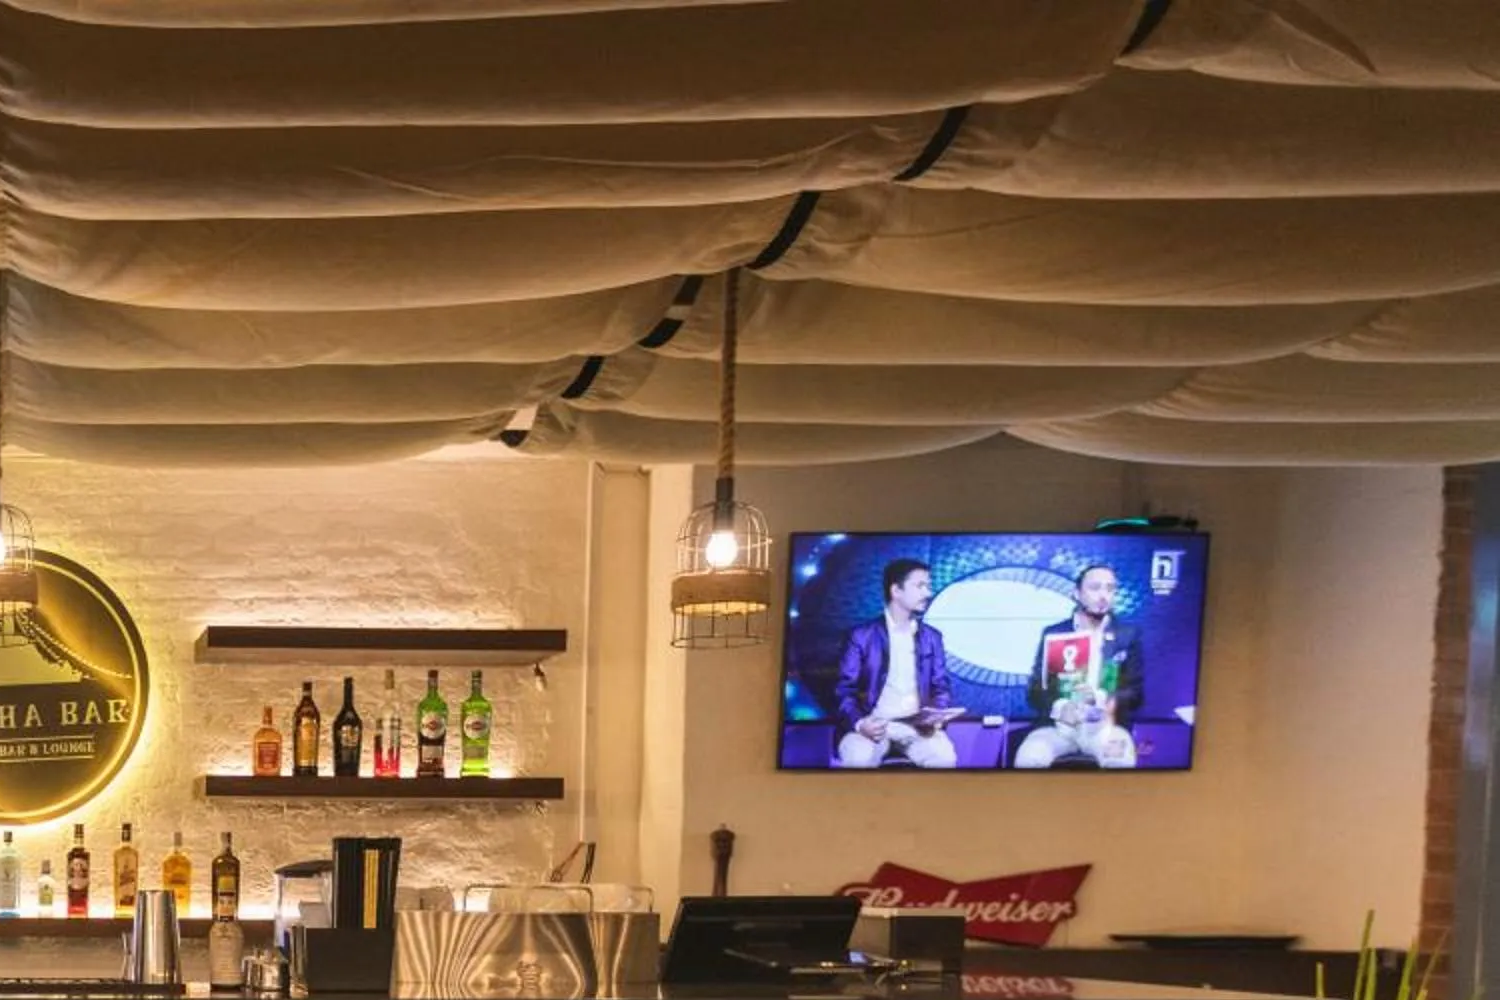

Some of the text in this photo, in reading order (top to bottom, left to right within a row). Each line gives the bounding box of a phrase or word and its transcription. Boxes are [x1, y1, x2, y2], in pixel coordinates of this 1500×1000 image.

[61, 698, 130, 725] BAR
[0, 744, 26, 758] BAR
[43, 740, 95, 755] LOUNGE
